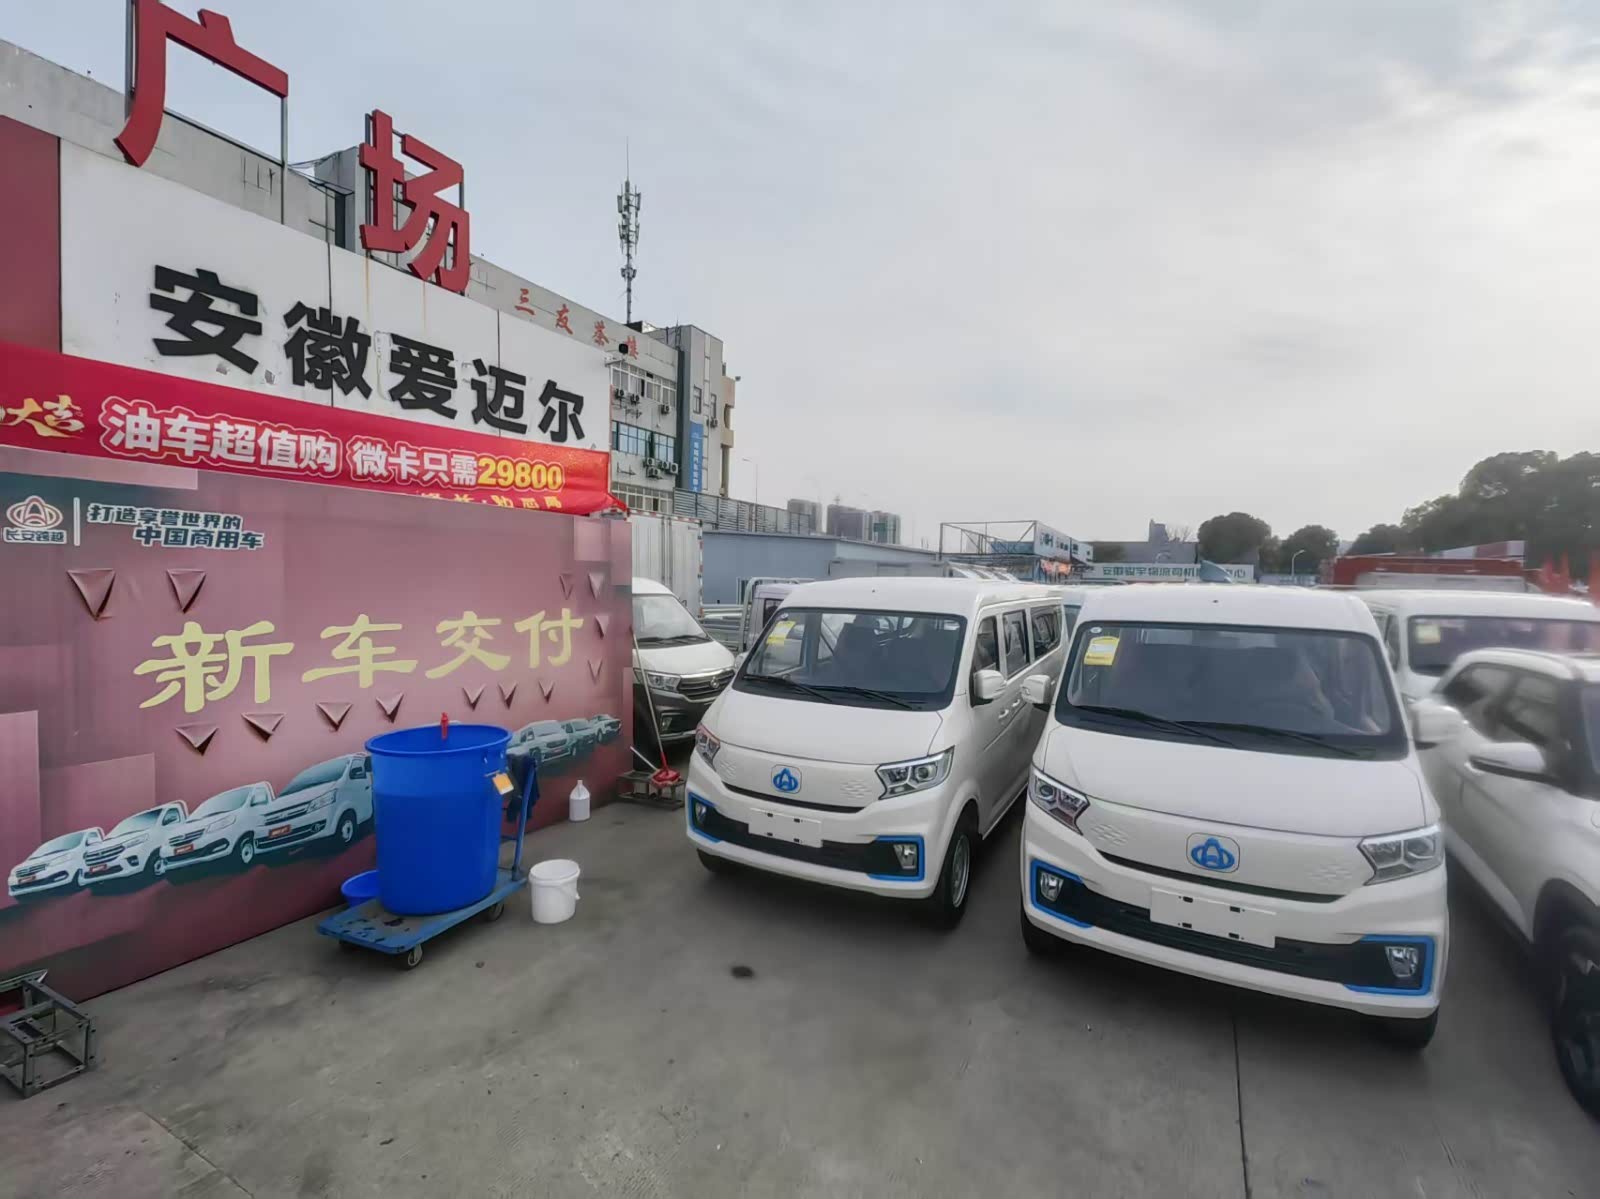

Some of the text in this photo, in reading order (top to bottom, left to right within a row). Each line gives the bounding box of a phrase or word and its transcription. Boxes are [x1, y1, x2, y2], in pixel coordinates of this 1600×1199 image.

[113, 0, 472, 294] 广场
[148, 264, 586, 444] 安徽爱迈尔
[107, 402, 338, 474] 油车超值购
[351, 440, 563, 490] 微卡只需29800
[88, 503, 243, 530] 打造享誉世界的
[133, 525, 264, 550] 中国商用车
[134, 607, 585, 713] 新车交付
